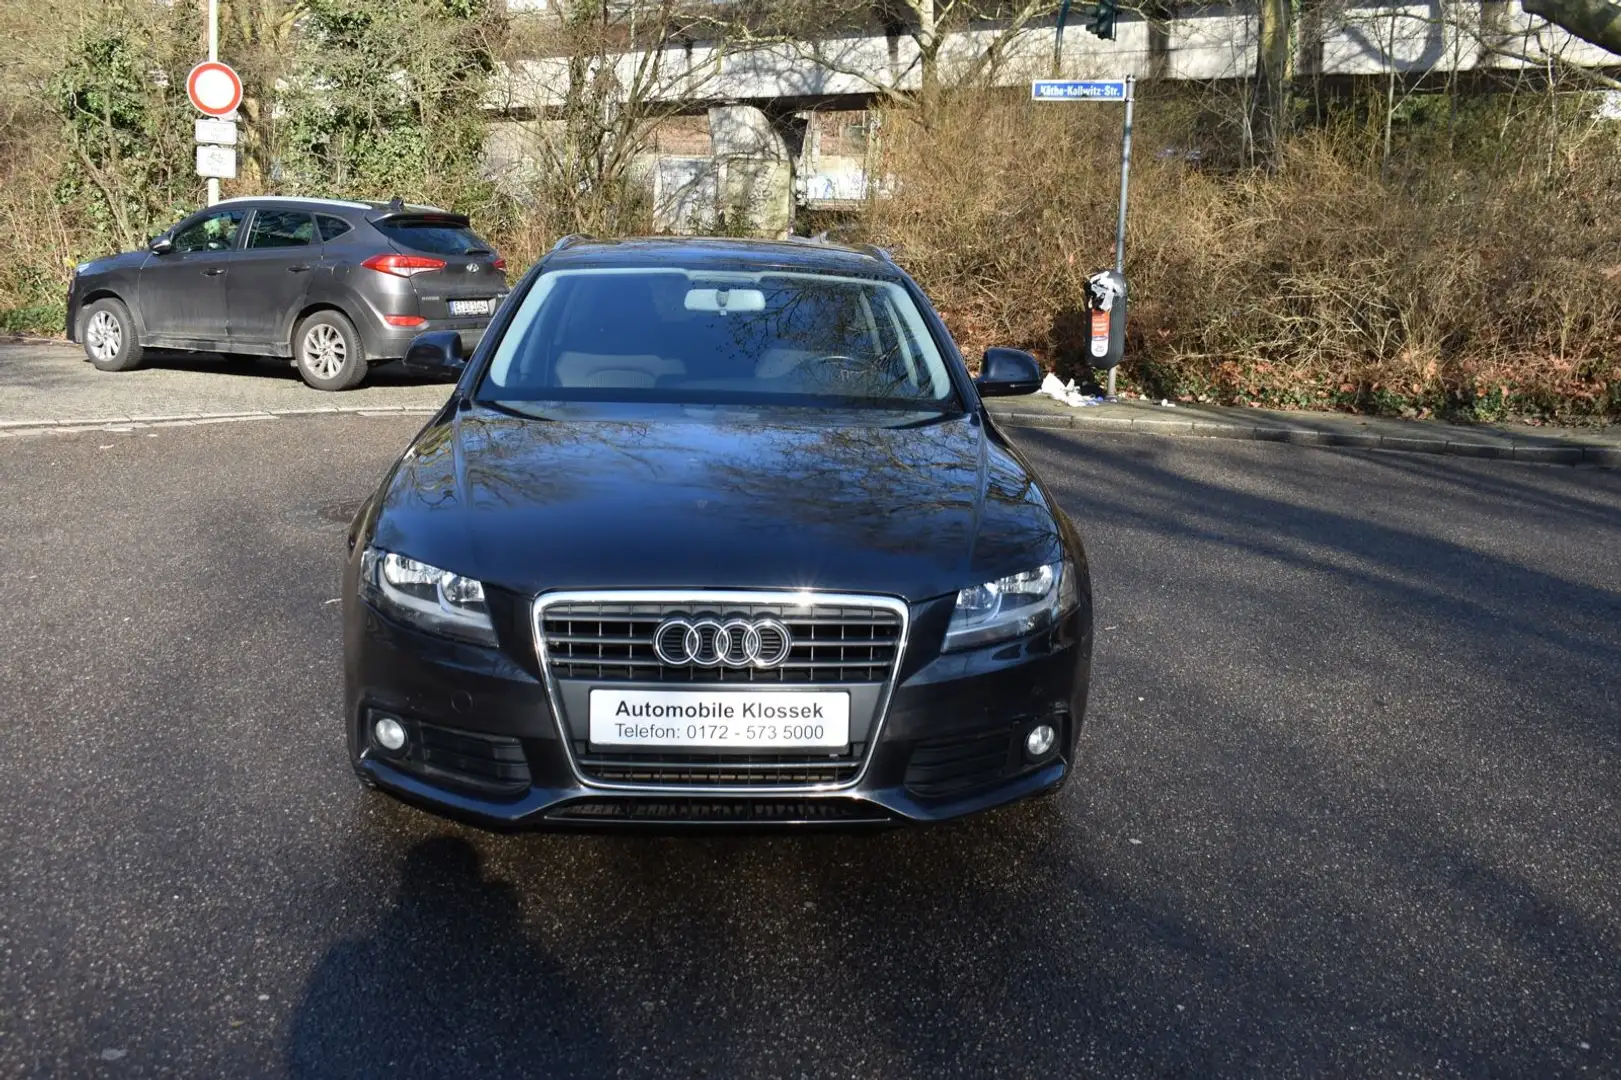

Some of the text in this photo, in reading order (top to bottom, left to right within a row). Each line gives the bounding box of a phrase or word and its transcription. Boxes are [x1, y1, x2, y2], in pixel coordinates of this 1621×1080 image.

[615, 700, 824, 719] Automobile Klossek
[615, 723, 681, 739] Telefon:
[686, 724, 729, 740] 0172
[746, 725, 777, 740] 573
[783, 725, 824, 740] 5000
